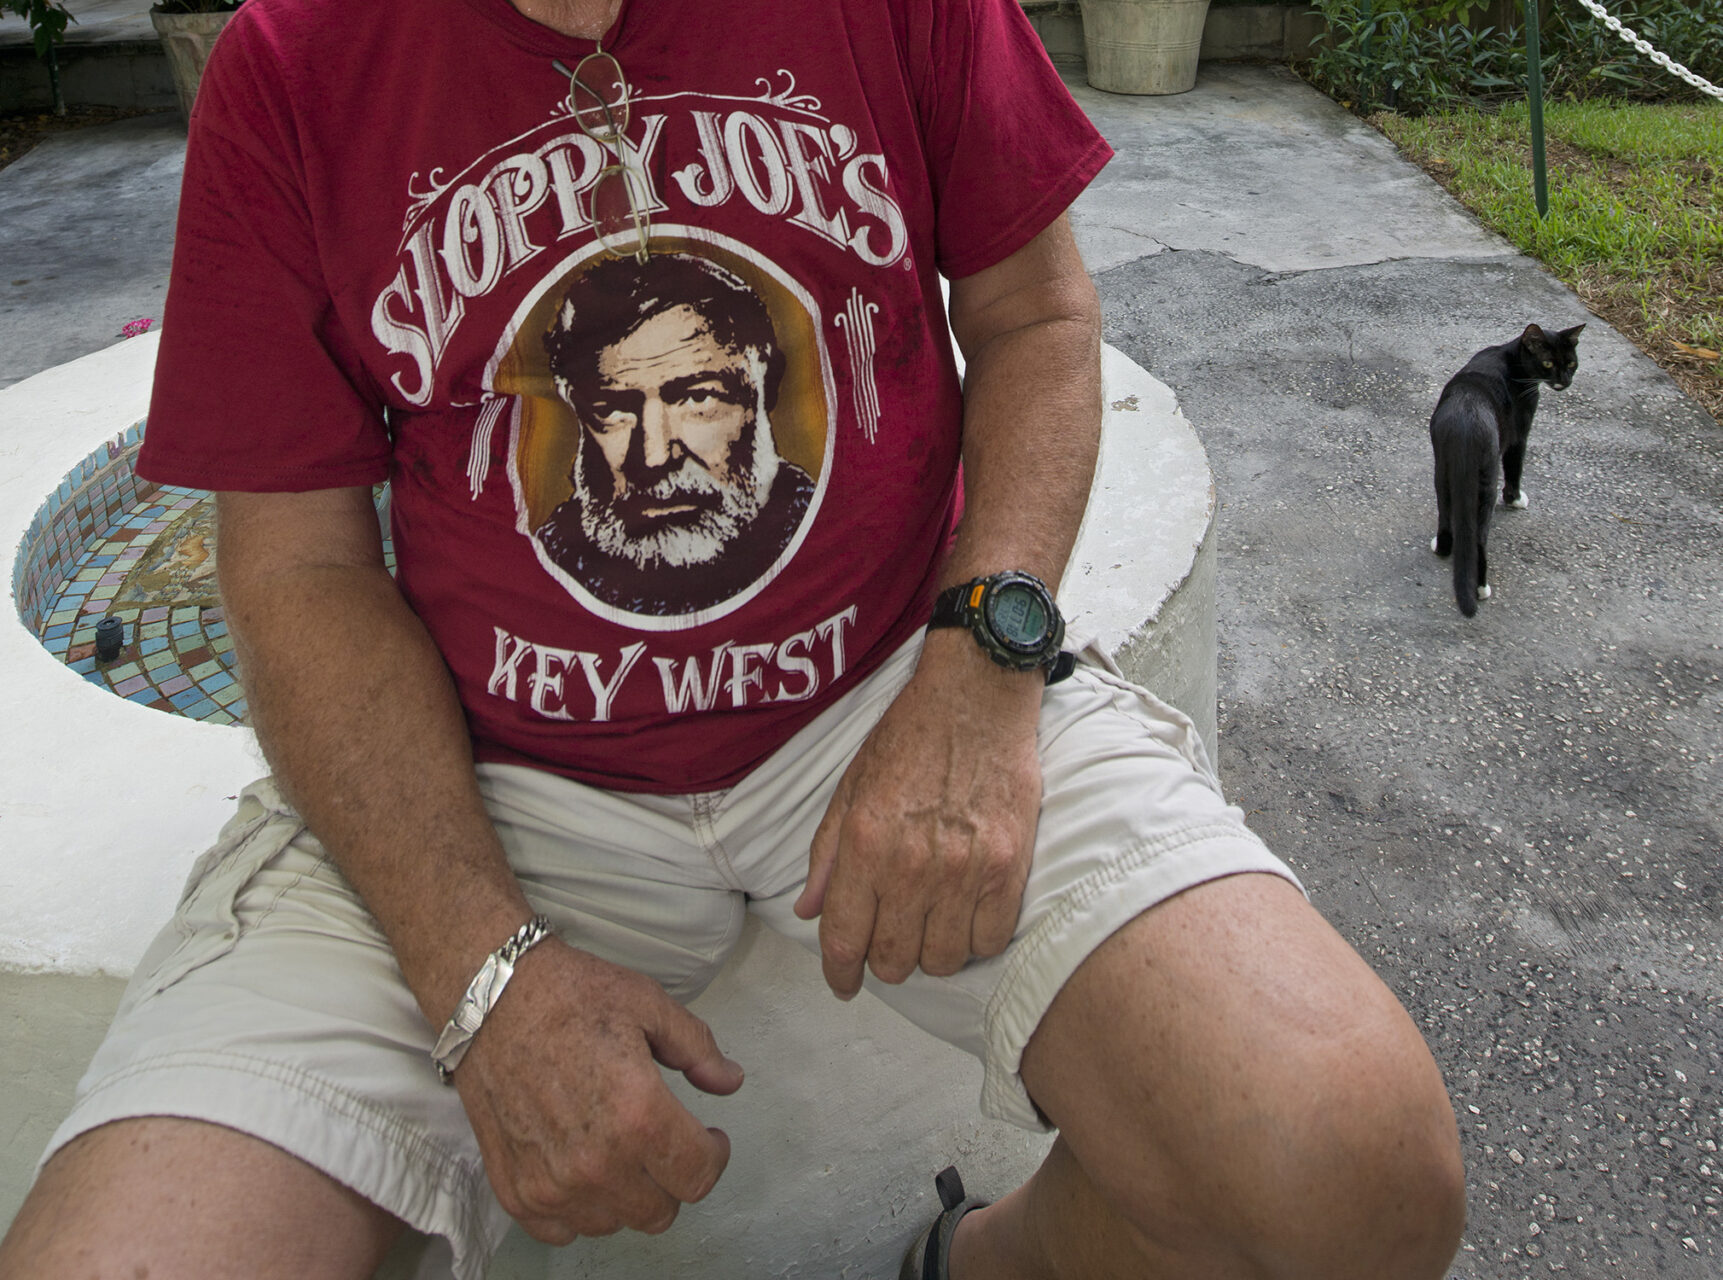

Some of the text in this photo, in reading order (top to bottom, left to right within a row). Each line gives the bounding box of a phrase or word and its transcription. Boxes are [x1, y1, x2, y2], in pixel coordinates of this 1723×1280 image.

[371, 111, 908, 407] SLOPPY JOE'S
[487, 605, 858, 721] KEY WEST
